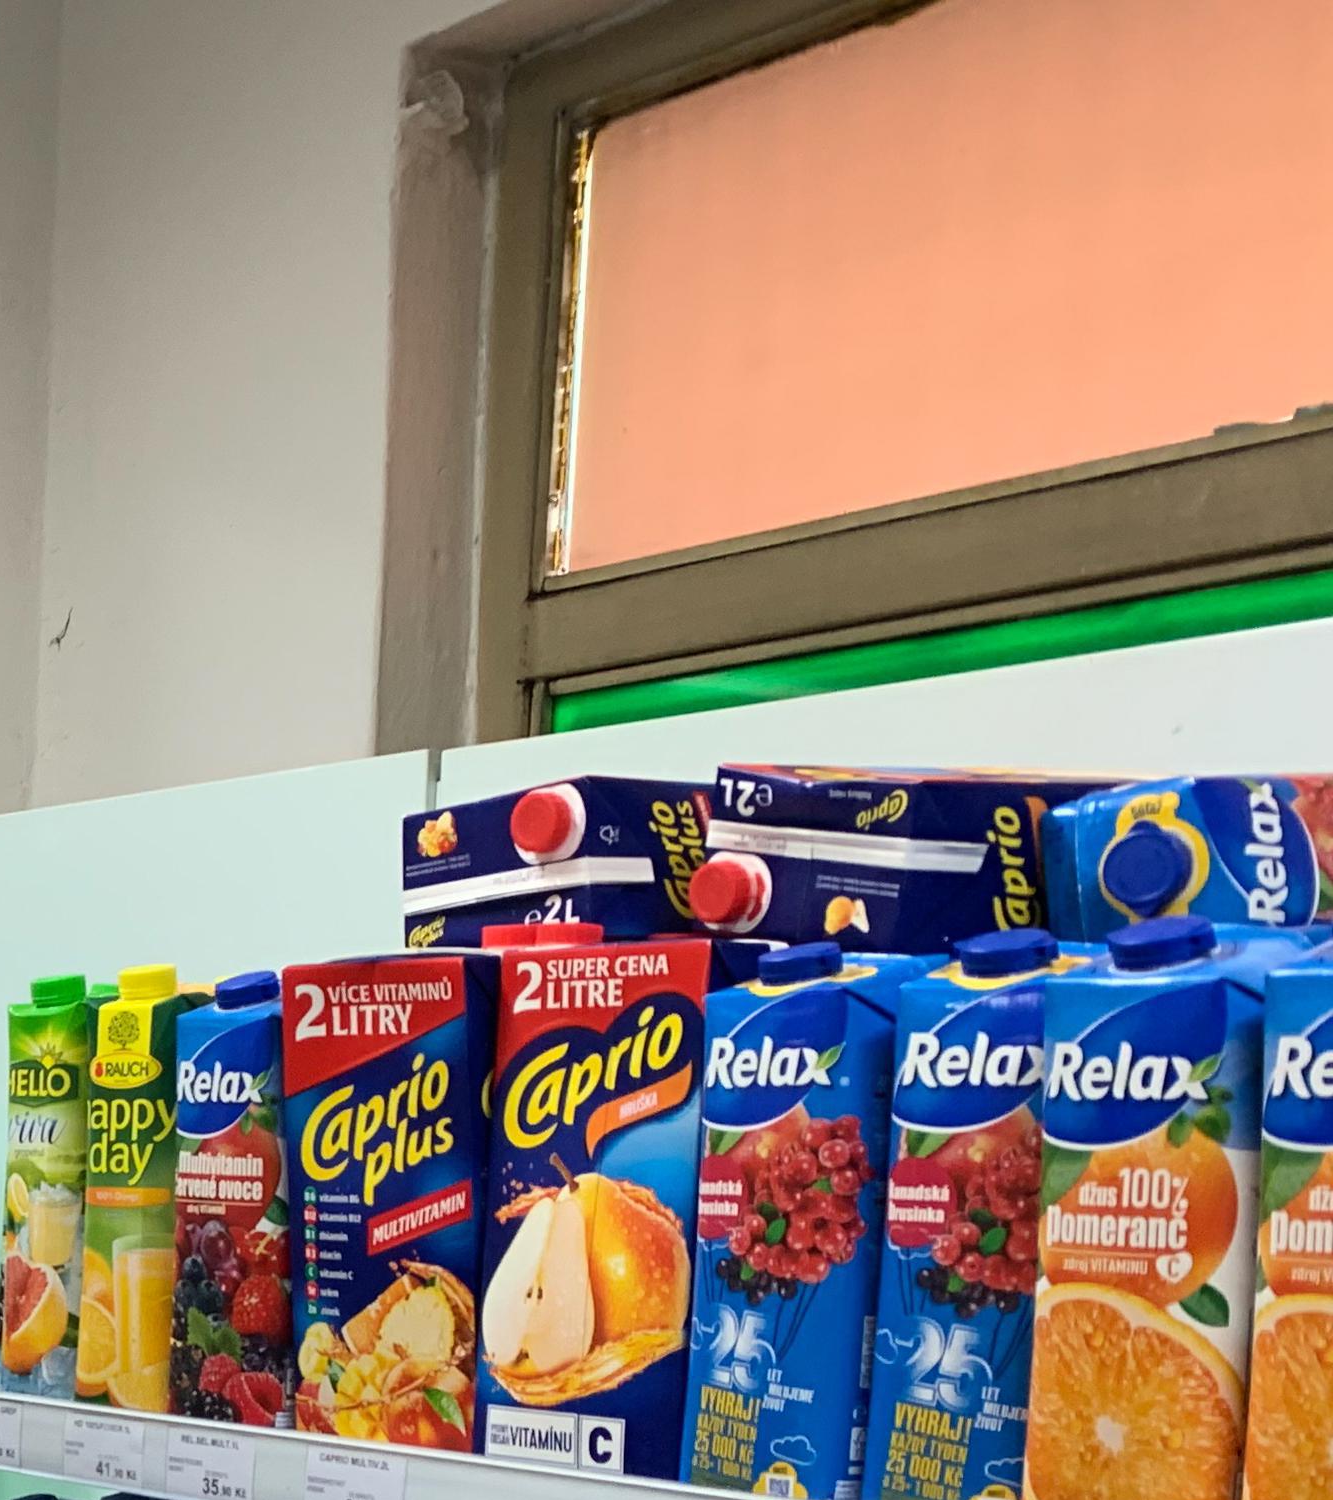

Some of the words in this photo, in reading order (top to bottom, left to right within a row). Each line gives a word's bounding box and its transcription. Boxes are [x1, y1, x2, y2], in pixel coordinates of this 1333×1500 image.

[1244, 782, 1290, 925] Relax
[295, 983, 328, 1042] 2
[329, 980, 371, 1002] VÍCE
[373, 975, 453, 1001] VITAMINŮ
[513, 961, 543, 1014] 2
[546, 957, 608, 979] SUPER
[614, 954, 670, 978] CENA
[546, 979, 624, 1010] LITRE
[332, 1002, 413, 1038] LITRY
[104, 1061, 151, 1078] RAUCH
[178, 1060, 264, 1104] Relax
[503, 1005, 685, 1150] Caprio
[706, 1036, 833, 1090] Relax
[1047, 1040, 1209, 1102] Relax
[87, 1098, 178, 1143] appy
[300, 1051, 450, 1182] Caprio
[89, 1132, 155, 1186] day
[362, 1116, 455, 1206] plus
[217, 1179, 264, 1201] ovoce
[1078, 1180, 1117, 1209] džus
[1119, 1166, 1189, 1220] 100%
[372, 1190, 467, 1247] MULTIVITAMIN
[510, 1425, 573, 1455] VITAMÍNU
[588, 1426, 614, 1464] C
[894, 1402, 974, 1445] VYHRAJ!
